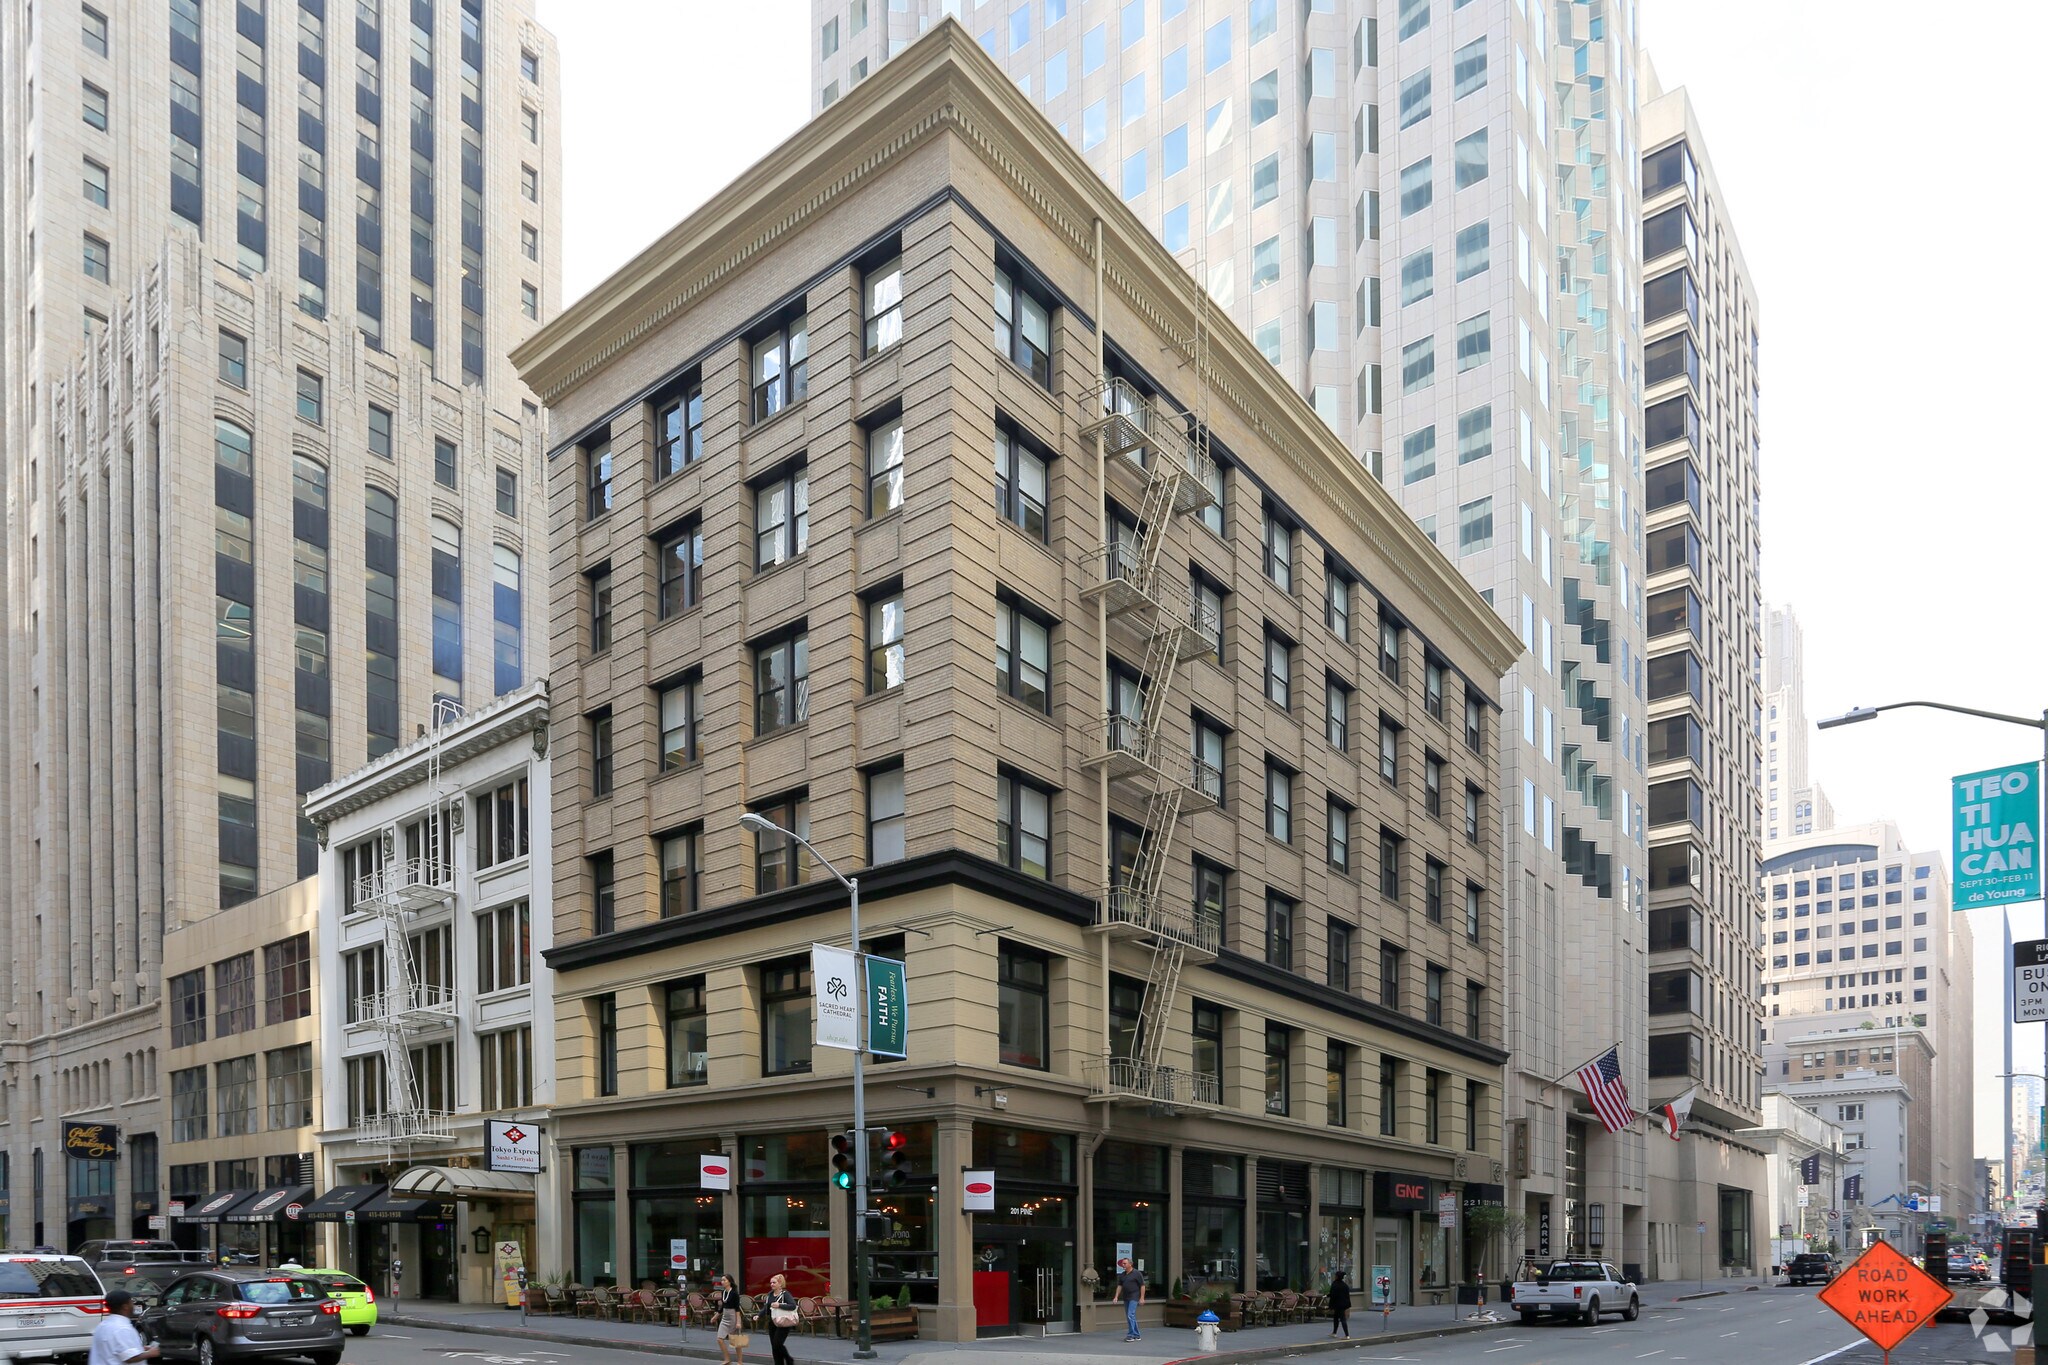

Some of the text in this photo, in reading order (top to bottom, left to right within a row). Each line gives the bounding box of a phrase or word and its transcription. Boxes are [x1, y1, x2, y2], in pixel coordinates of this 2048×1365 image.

[1960, 771, 2029, 802] TEO
[1960, 802, 1990, 827] TI
[1960, 822, 2034, 853] HUA
[1960, 847, 2032, 876] CAN
[1960, 879, 1983, 889] SEPT
[2024, 872, 2034, 880] 11
[1968, 888, 2026, 902] de Young
[2023, 968, 2048, 981] BU
[819, 1002, 855, 1013] SACRED HEART
[877, 985, 888, 1026] FAITH
[2020, 998, 2042, 1007] 3PM
[823, 1008, 852, 1018] CATHEDRAL
[891, 1005, 898, 1017] We
[2023, 1008, 2045, 1016] MON
[491, 1146, 540, 1156] Tokyo Express
[1395, 1183, 1424, 1200] GNC
[440, 1204, 455, 1213] 77
[1010, 1207, 1033, 1215] 201 PINE
[1541, 1214, 1549, 1245] PARK
[1858, 1268, 1908, 1282] ROAD
[1858, 1289, 1910, 1303] WORK
[1855, 1310, 1917, 1323] AHEAD
